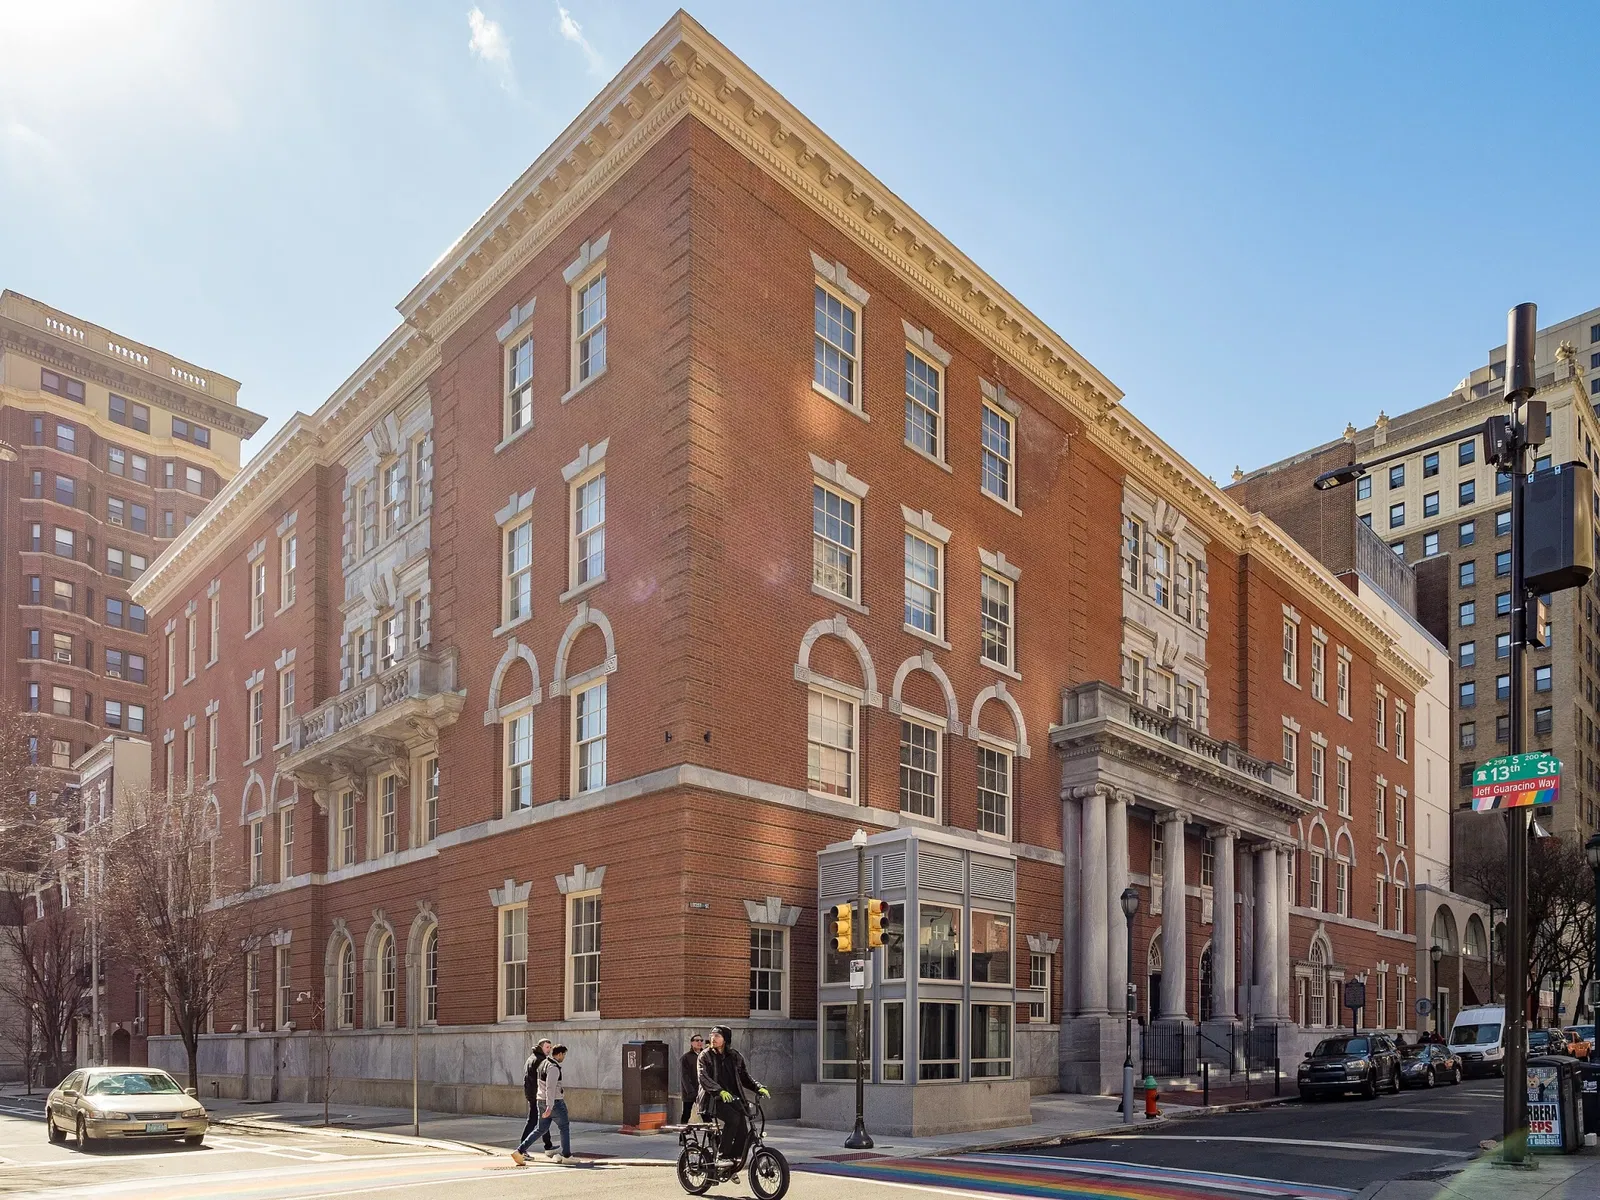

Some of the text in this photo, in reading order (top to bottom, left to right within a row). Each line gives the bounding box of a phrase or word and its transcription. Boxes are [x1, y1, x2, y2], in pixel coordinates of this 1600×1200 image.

[1512, 756, 1519, 764] S
[1491, 761, 1556, 781] 13th St
[1476, 779, 1556, 797] Jeff Guaracino Way
[1527, 1105, 1557, 1120] RBERA
